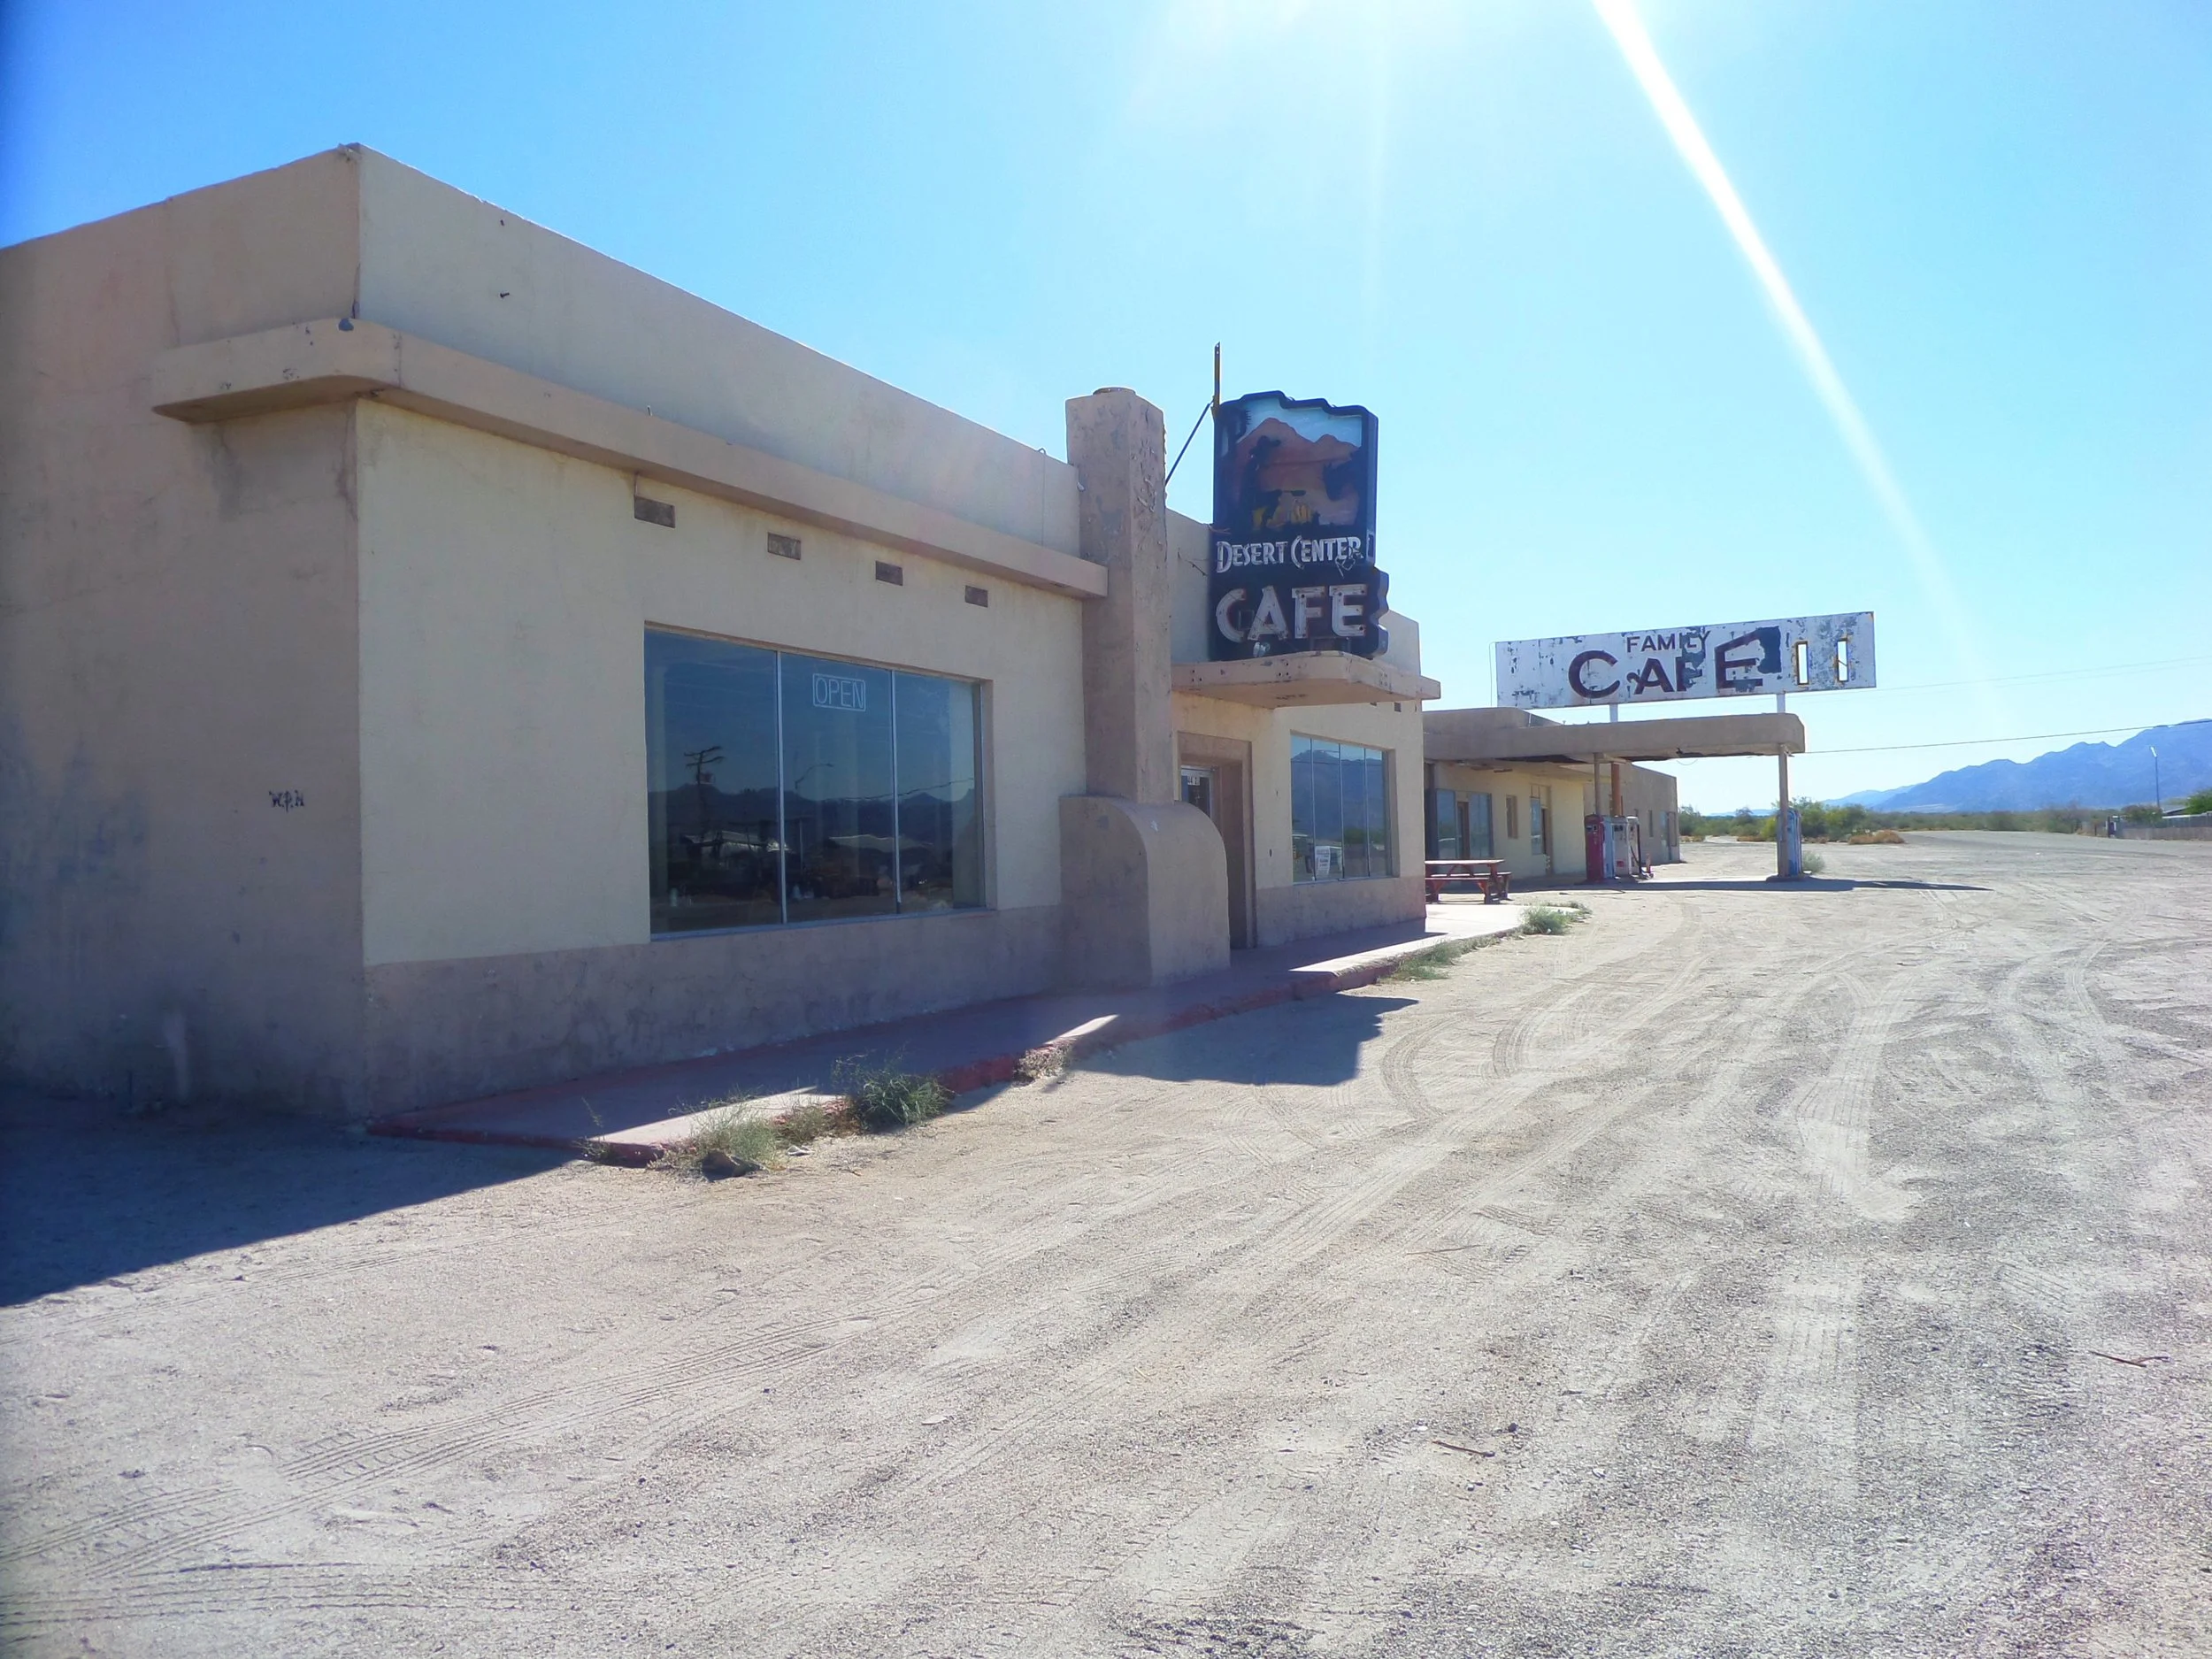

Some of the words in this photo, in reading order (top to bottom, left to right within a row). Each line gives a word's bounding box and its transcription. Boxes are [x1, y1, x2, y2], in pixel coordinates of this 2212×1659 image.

[1216, 541, 1288, 573] DESERT
[1291, 534, 1363, 570] CENTER
[1216, 583, 1367, 643] CAFE
[1626, 630, 1711, 653] FAMILY
[816, 677, 864, 709] OPEN
